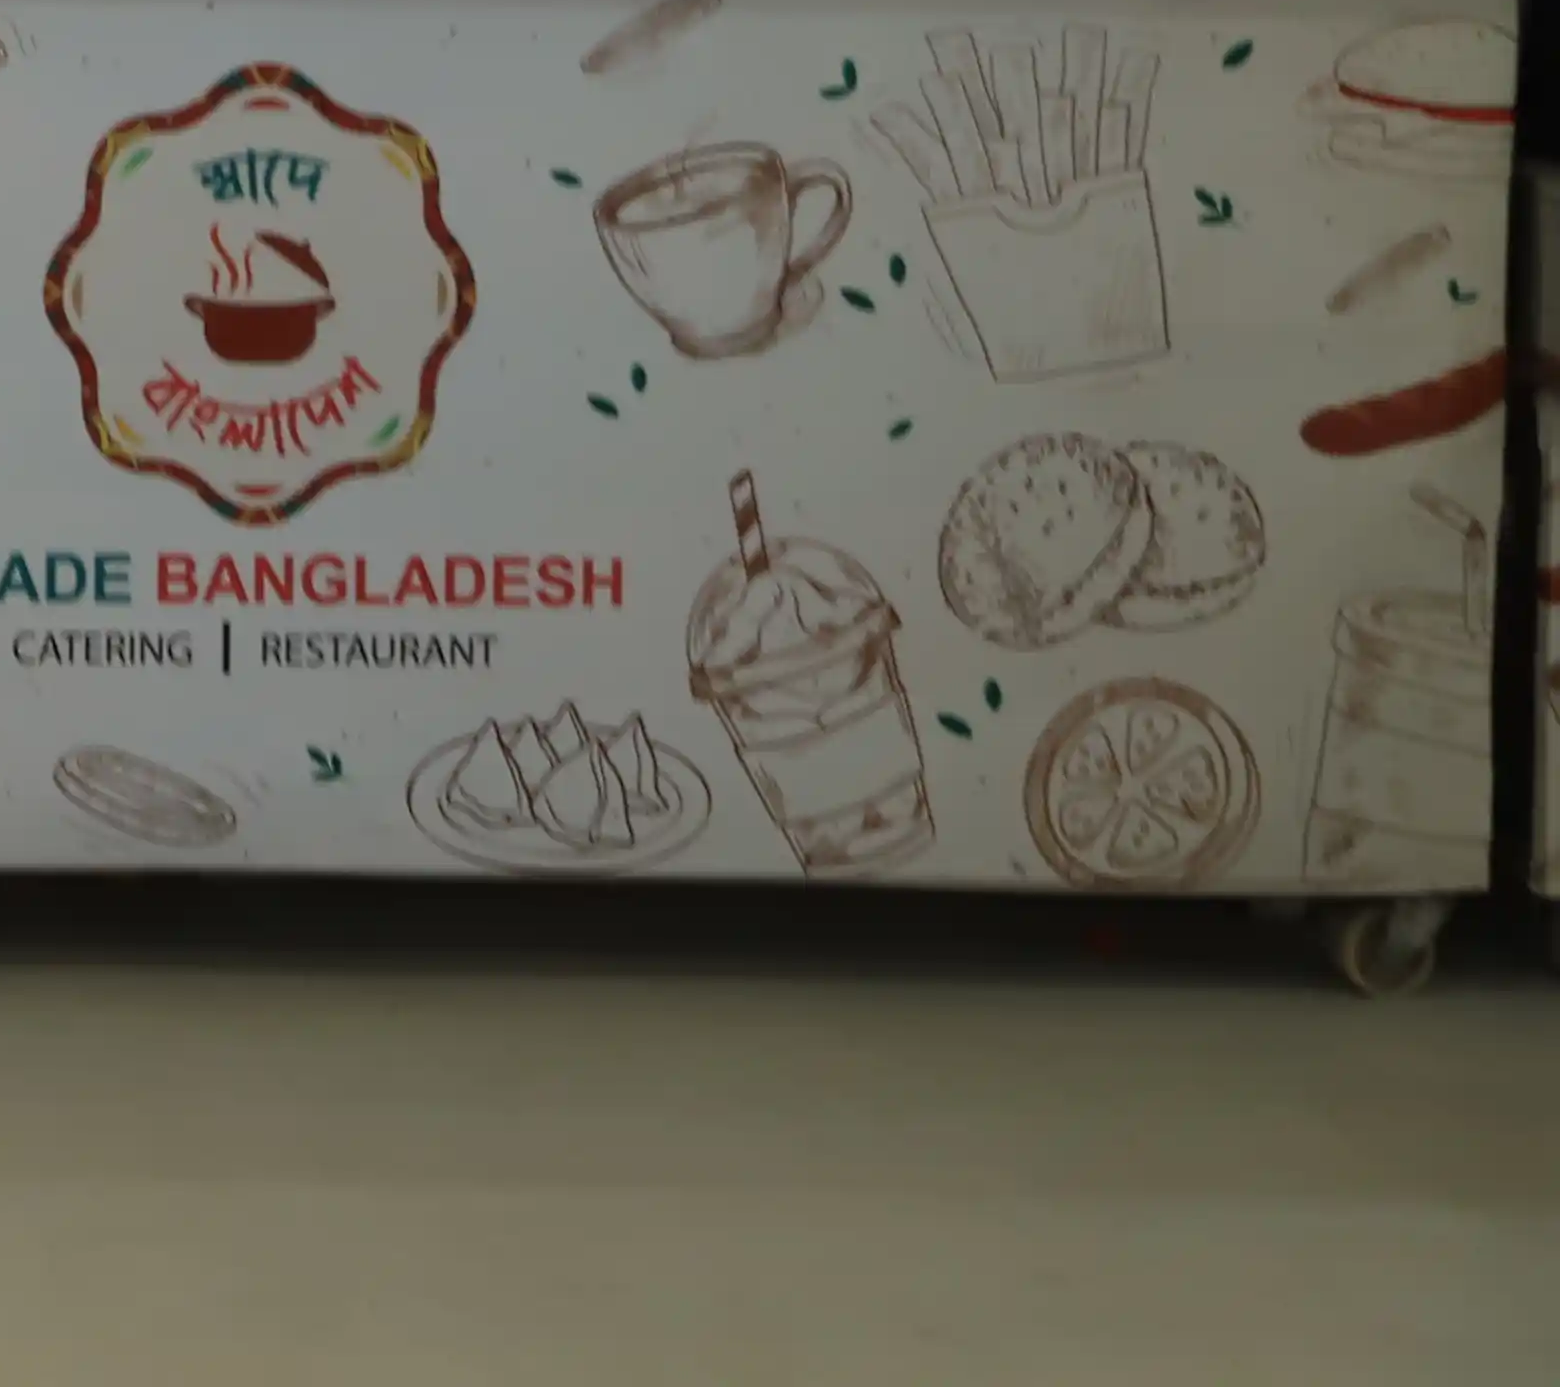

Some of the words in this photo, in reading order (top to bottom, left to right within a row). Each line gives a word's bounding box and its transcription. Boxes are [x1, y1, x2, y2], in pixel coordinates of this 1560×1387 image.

[141, 354, 384, 460] বাংলাদেশ
[155, 551, 626, 611] BANGLADESH
[11, 629, 194, 669] CATERING
[260, 630, 500, 671] RESTAURANT
